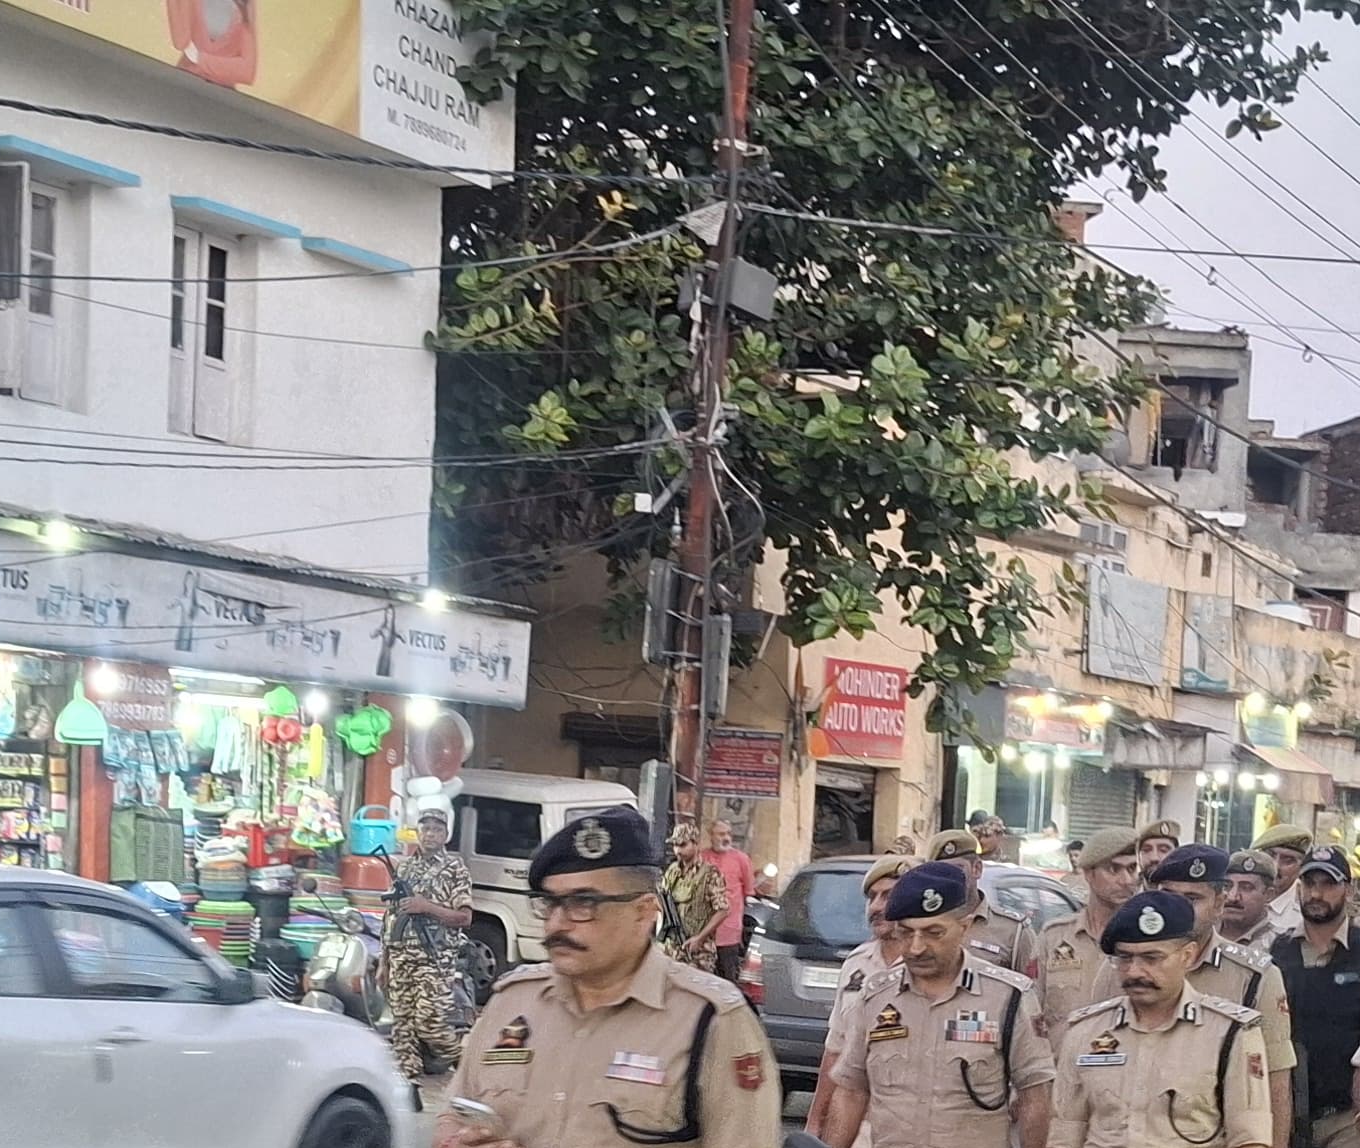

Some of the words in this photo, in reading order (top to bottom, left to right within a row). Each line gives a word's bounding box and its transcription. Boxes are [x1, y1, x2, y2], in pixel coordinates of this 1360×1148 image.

[394, 0, 462, 43] KHAZAN
[398, 35, 457, 78] CHAND
[373, 64, 439, 112] CHAJJU
[444, 93, 480, 129] RAM
[408, 629, 447, 651] VECTUS
[824, 700, 859, 733] AUTO
[861, 704, 905, 738] WORKS
